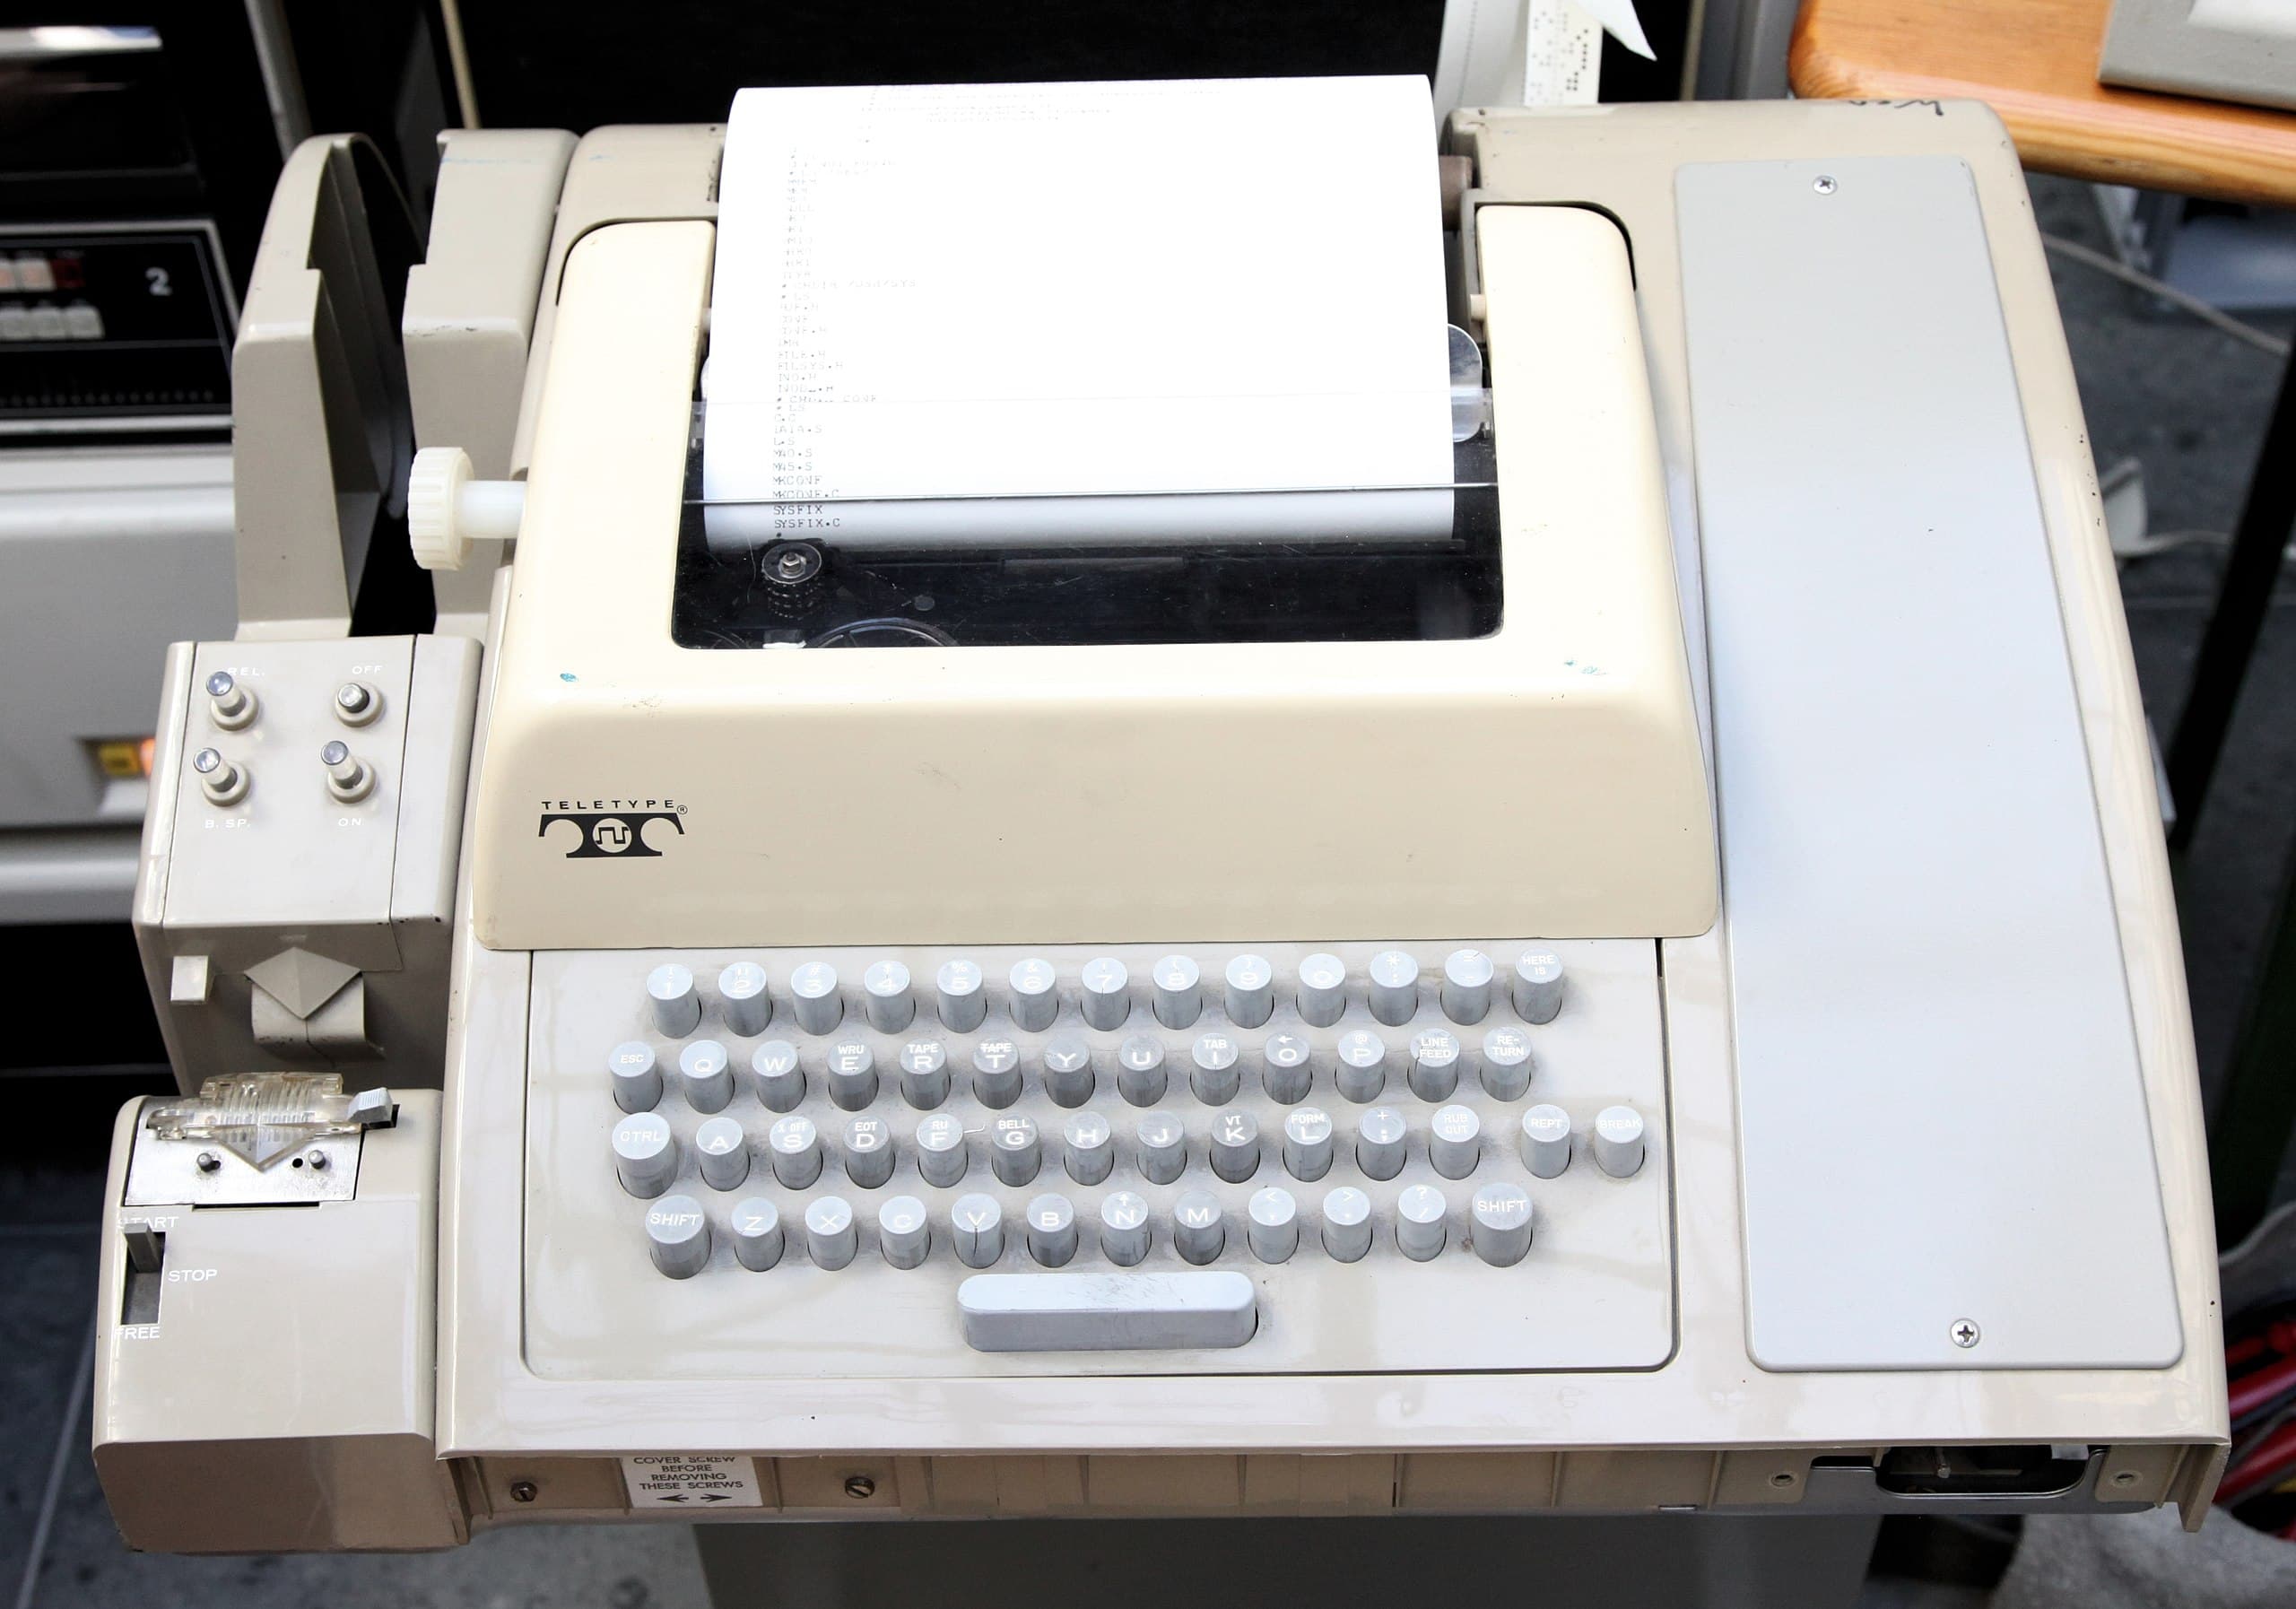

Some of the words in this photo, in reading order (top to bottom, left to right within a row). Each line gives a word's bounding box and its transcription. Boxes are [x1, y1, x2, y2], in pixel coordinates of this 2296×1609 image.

[145, 267, 173, 296] 2
[772, 475, 822, 485] MKCONF
[772, 489, 839, 499] MKCONF.C
[773, 505, 823, 516] SYSFIX
[774, 517, 840, 528] SYSFIX.C
[352, 665, 384, 675] OFF
[338, 817, 362, 827] ON
[1522, 954, 1556, 965] HERE
[1535, 966, 1548, 975] IS
[951, 977, 969, 990] 5
[1022, 975, 1042, 989] 6
[1096, 974, 1114, 994] 7
[1167, 972, 1187, 985] 8
[1240, 971, 1259, 985] 9
[731, 979, 752, 993] 2
[804, 978, 823, 992] 3
[876, 979, 897, 992] 4
[907, 1042, 939, 1054] TAPE
[980, 1042, 1013, 1054] TAPE
[1204, 1039, 1228, 1049] TAB
[1421, 1037, 1449, 1048] LINE
[837, 1044, 865, 1055] WRU
[1353, 1048, 1372, 1061] P
[1419, 1048, 1452, 1059] FEED
[1492, 1046, 1525, 1057] TURN
[620, 1054, 644, 1065] ESC
[764, 1057, 788, 1070] W
[840, 1057, 860, 1072] E
[914, 1055, 933, 1070] R
[984, 1054, 1007, 1069] T
[1056, 1052, 1077, 1067] Y
[1132, 1051, 1152, 1065] U
[693, 1058, 713, 1073] Q
[932, 1120, 948, 1130] RU
[998, 1118, 1031, 1130] BELL
[1225, 1116, 1242, 1126] VT
[1291, 1113, 1325, 1125] FORM
[1444, 1113, 1469, 1124] RUB
[1530, 1118, 1563, 1129] REPT
[1598, 1118, 1642, 1129] BREAK
[790, 1120, 810, 1132] OFF
[854, 1121, 878, 1132] EOT
[1300, 1125, 1320, 1140] L
[1445, 1125, 1469, 1135] OUT
[619, 1130, 662, 1143] CTRL
[856, 1133, 875, 1148] D
[931, 1131, 948, 1145] F
[1005, 1131, 1025, 1144] G
[1076, 1129, 1097, 1144] H
[1153, 1128, 1168, 1143] J
[1225, 1126, 1246, 1142] K
[709, 1135, 729, 1150] A
[783, 1134, 803, 1148] S
[1477, 1198, 1528, 1213] SHIFT
[649, 1212, 701, 1227] SHIFT
[820, 1214, 841, 1229] X
[893, 1213, 912, 1229] C
[967, 1211, 987, 1227] V
[1041, 1212, 1059, 1227] B
[1116, 1209, 1135, 1223] N
[1187, 1207, 1208, 1223] M
[745, 1215, 765, 1231] Z
[168, 1269, 219, 1283] STOP
[633, 1457, 682, 1465] COVER
[662, 1464, 713, 1473] BEFORE
[650, 1473, 728, 1483] REMOVING
[639, 1483, 682, 1491] THESE
[687, 1481, 744, 1490] SCREWS
